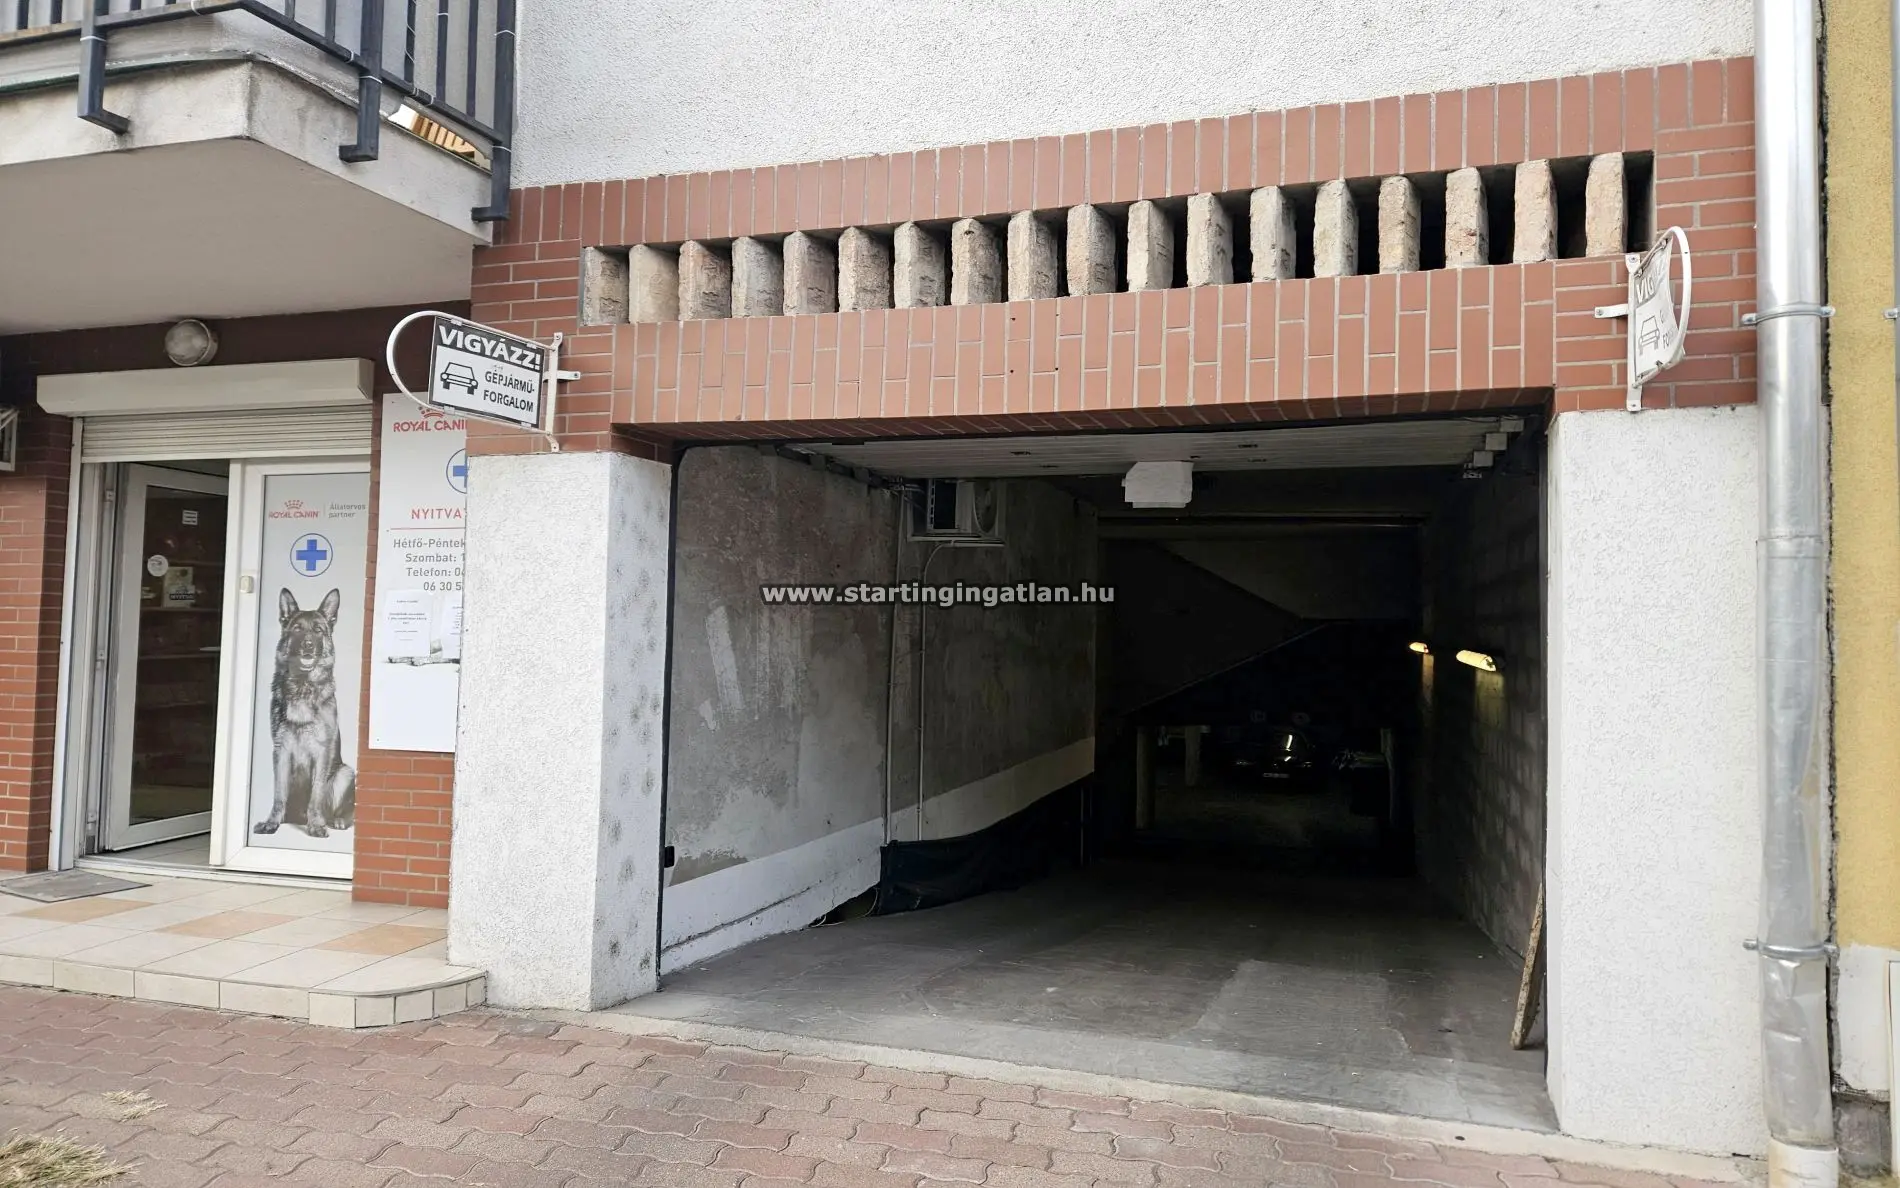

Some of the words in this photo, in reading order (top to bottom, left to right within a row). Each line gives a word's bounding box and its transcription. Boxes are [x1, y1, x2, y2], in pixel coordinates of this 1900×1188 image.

[439, 324, 541, 370] VIGYÁZZ!
[483, 390, 534, 413] FORGALOM
[393, 421, 431, 433] ROYAL
[268, 511, 292, 519] ROYAL
[293, 511, 319, 519] CANIN
[411, 508, 463, 520] NYITVA
[405, 552, 457, 563] Szombat:
[406, 567, 451, 577] Telefon:
[423, 581, 436, 591] 06
[439, 581, 453, 591] 30
